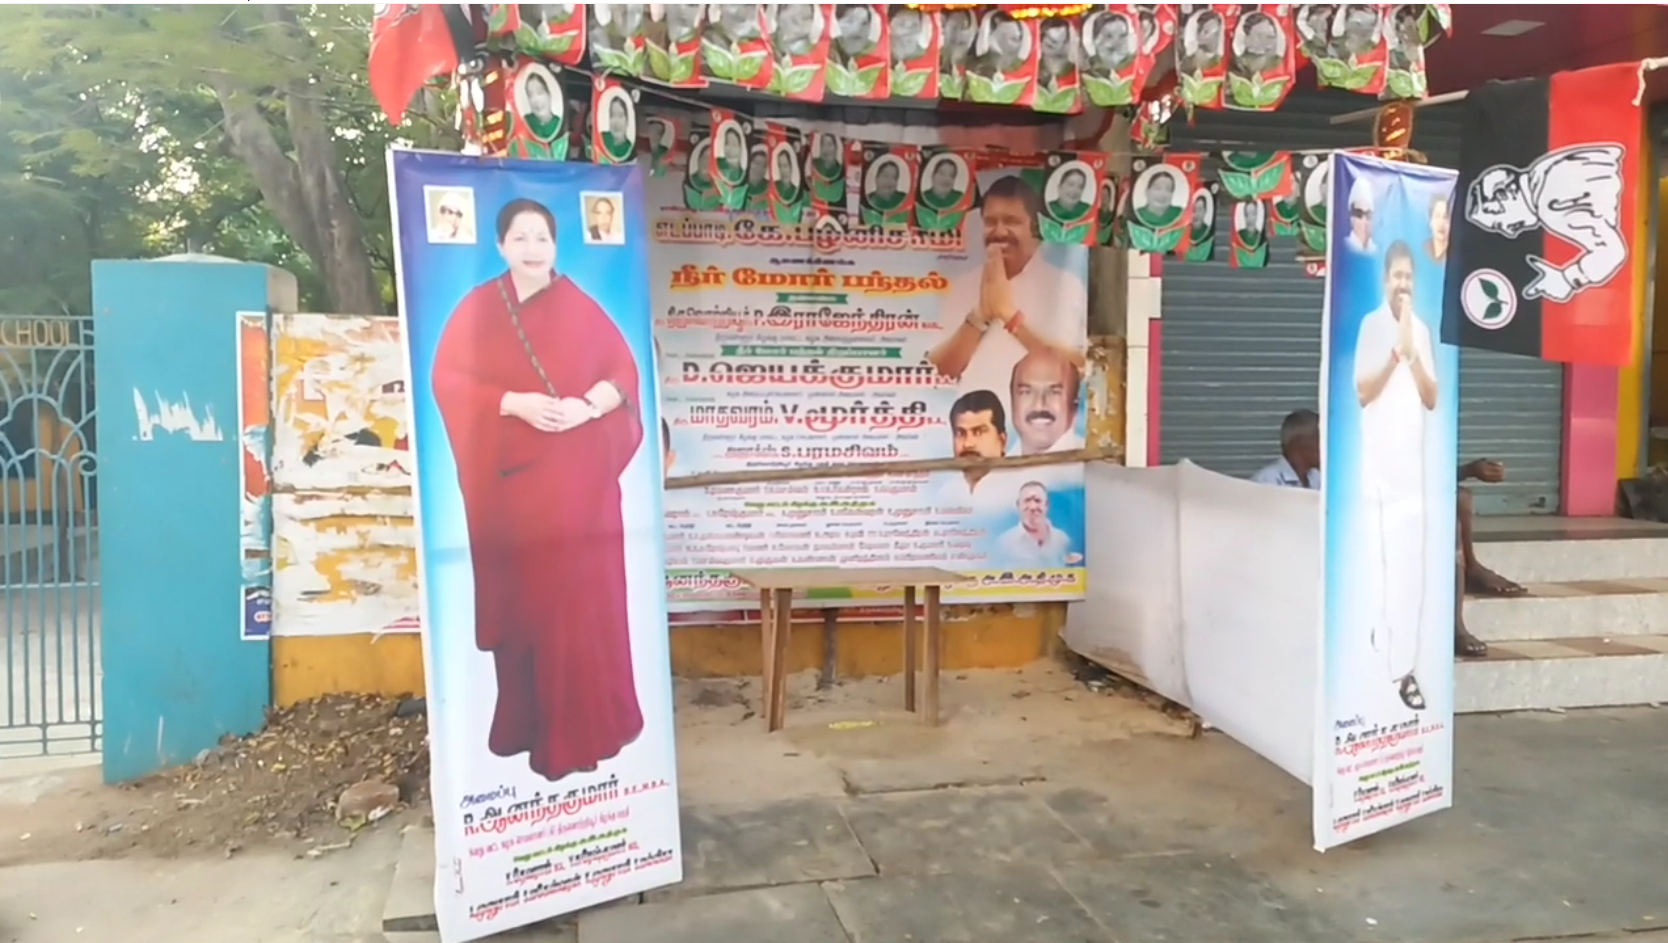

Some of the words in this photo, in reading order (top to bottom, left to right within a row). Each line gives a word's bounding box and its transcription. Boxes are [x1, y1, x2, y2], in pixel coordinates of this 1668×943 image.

[671, 264, 726, 290] நீர்
[732, 266, 836, 289] மோர்
[841, 269, 949, 294] பந்தல்
[682, 359, 934, 389] D.ஜெயக்குமார்
[780, 400, 927, 432] V.மூர்த்தி
[781, 443, 899, 459] S.பரமசிவம்
